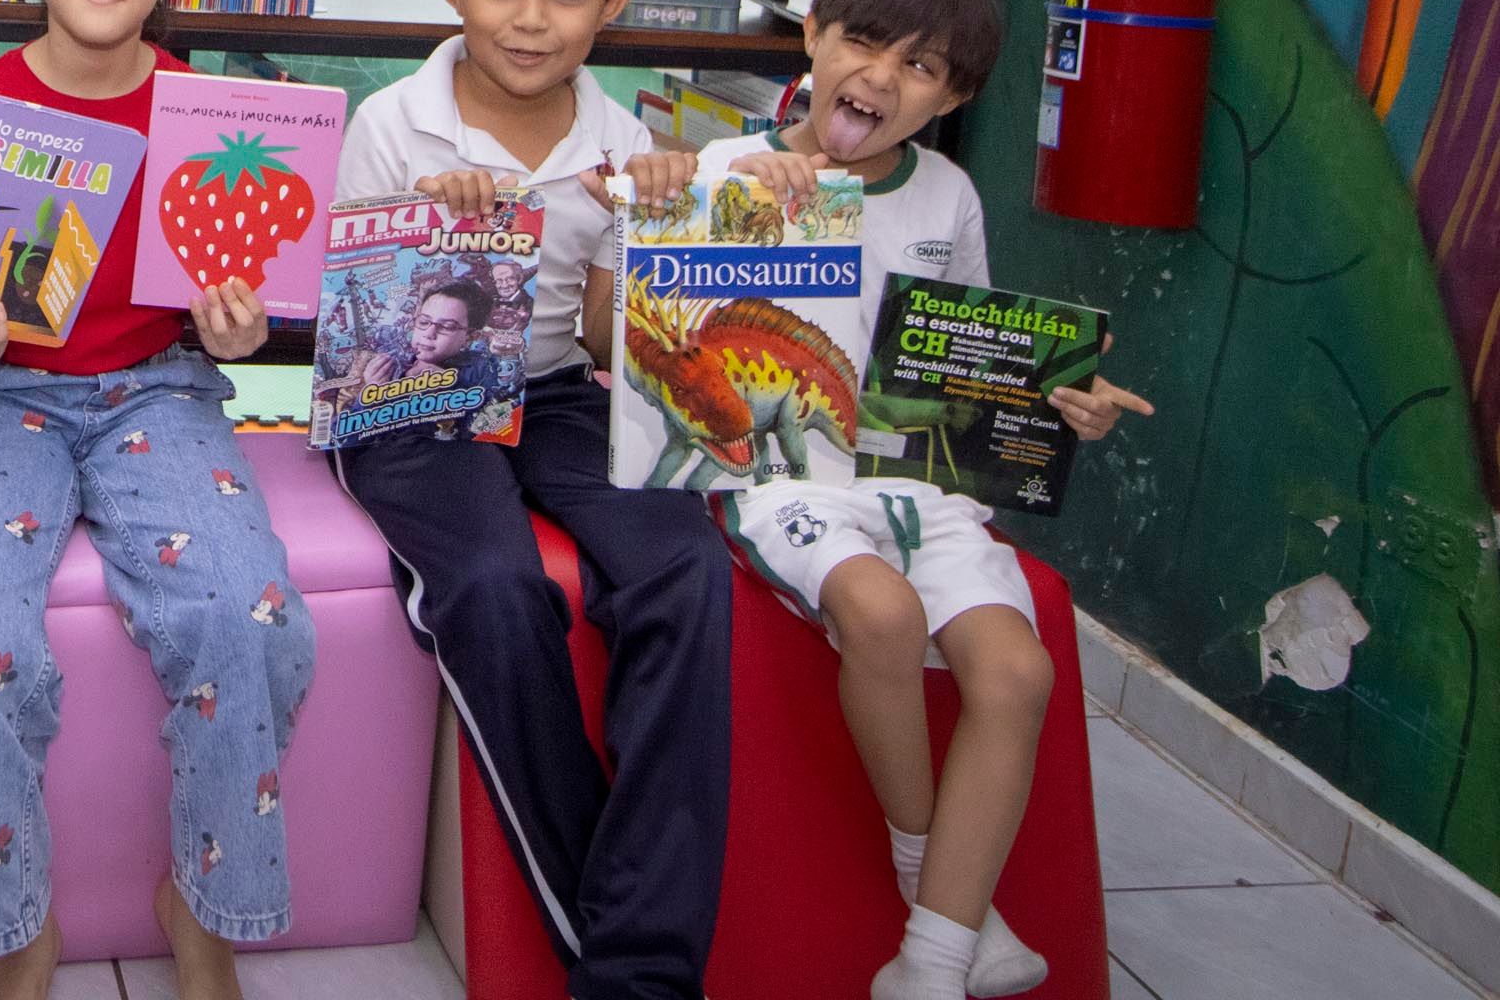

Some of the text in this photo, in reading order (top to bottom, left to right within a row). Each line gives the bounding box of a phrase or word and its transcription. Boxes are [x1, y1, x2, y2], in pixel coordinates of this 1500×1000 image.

[160, 106, 336, 129] POCAS, MUCHAS ¡MUCHAS MÁS!
[15, 127, 85, 153] empezó
[330, 227, 430, 249] INTERESANTE
[417, 227, 535, 255] JUNIOR
[612, 215, 625, 314] Dinosaurios
[650, 252, 856, 288] Dinosaurios
[910, 290, 1077, 341] Tenochtitlán
[901, 327, 950, 358] CH
[904, 314, 1032, 346] se escribe con
[893, 368, 941, 384] with CH
[897, 355, 1028, 388] Tenochtitlán is spelled
[361, 369, 457, 405] Grandes
[337, 388, 484, 437] inventores
[993, 420, 1020, 433] Bolán
[995, 410, 1061, 431] Brenda Cantú
[763, 463, 805, 476] OCEANO
[776, 502, 810, 528] Football
